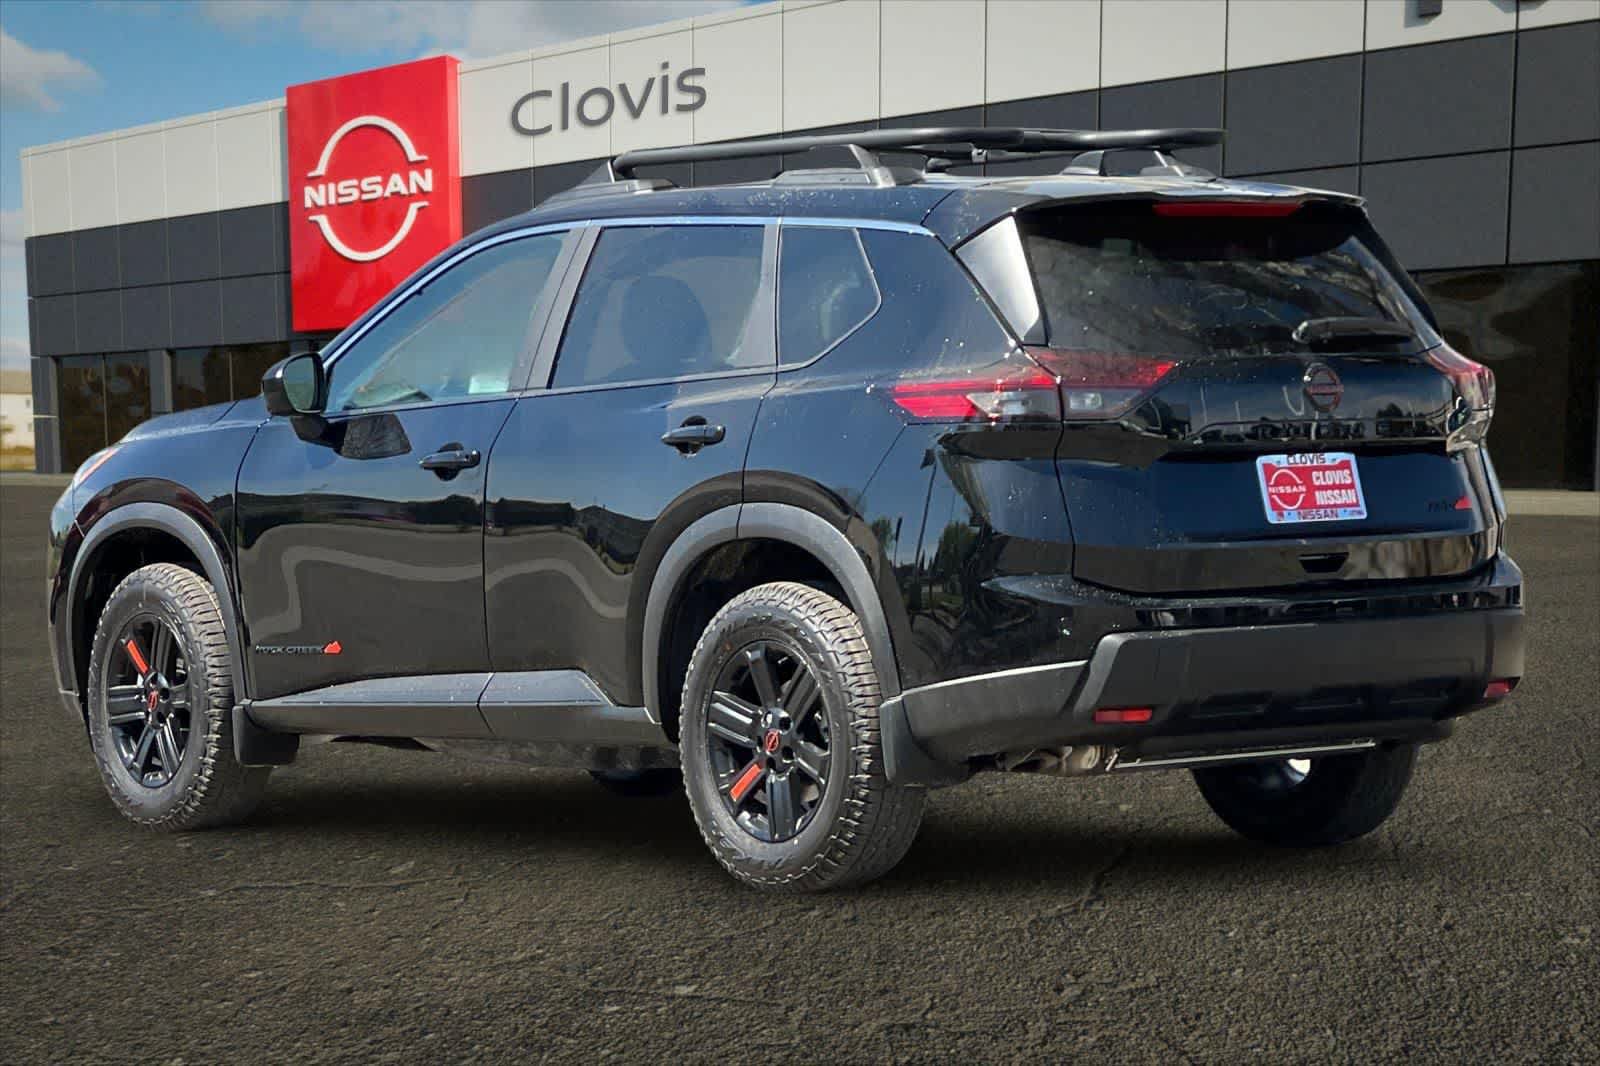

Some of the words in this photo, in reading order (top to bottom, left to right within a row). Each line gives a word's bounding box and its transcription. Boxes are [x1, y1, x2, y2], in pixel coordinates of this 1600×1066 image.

[511, 61, 708, 136] Clovis
[303, 169, 433, 208] NISSAN
[1286, 453, 1326, 465] CLOVIS
[1312, 470, 1353, 486] CLOVIS
[1268, 485, 1307, 494] NISSAN
[1315, 489, 1357, 505] NISSAN
[1298, 509, 1338, 520] NISSAN
